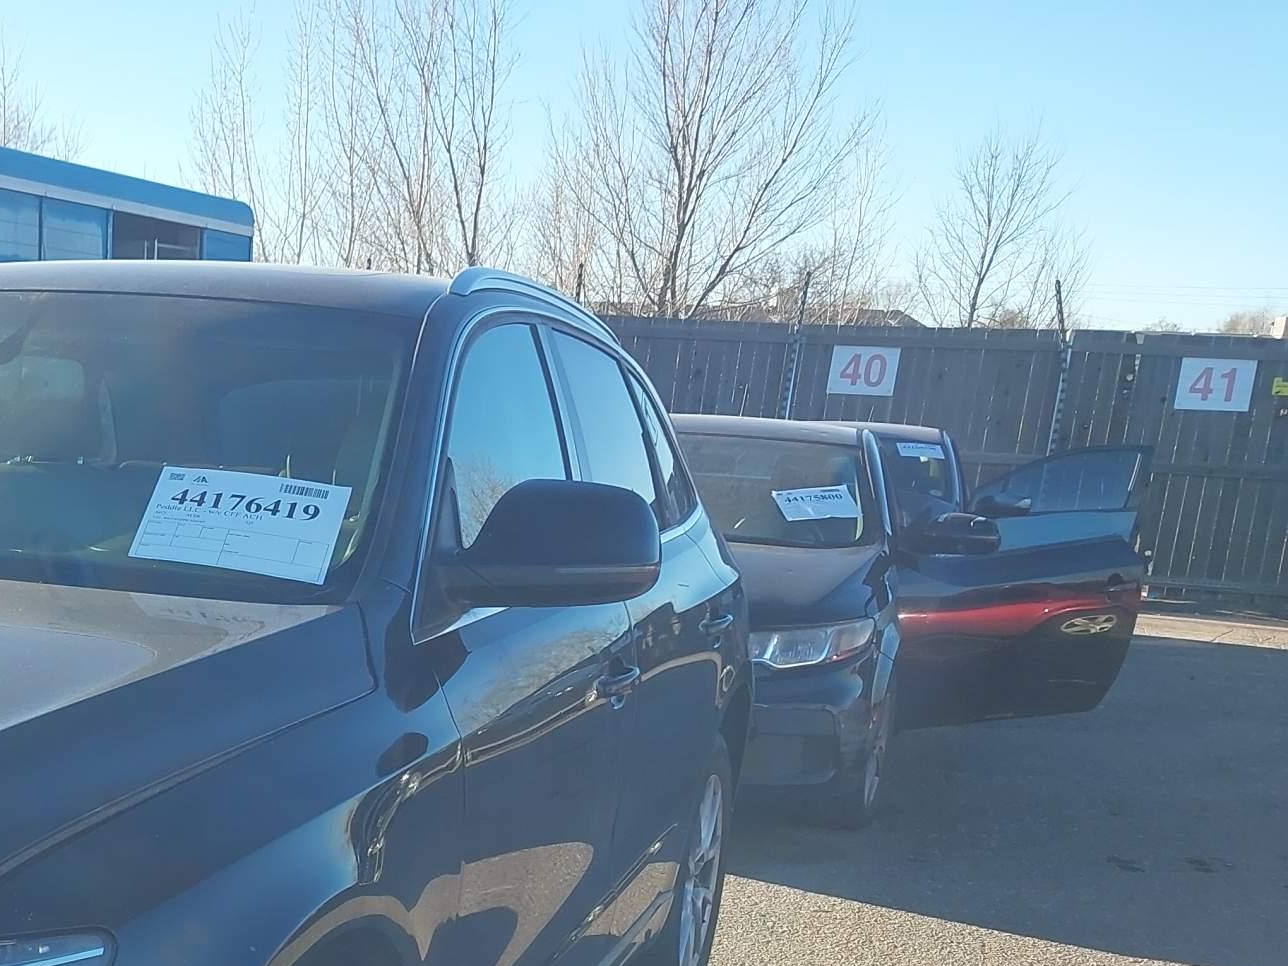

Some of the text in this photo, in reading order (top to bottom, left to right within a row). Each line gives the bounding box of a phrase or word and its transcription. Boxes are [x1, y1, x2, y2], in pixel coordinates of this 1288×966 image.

[839, 352, 887, 388] 40
[1188, 367, 1237, 402] 41
[170, 488, 320, 521] 44176419
